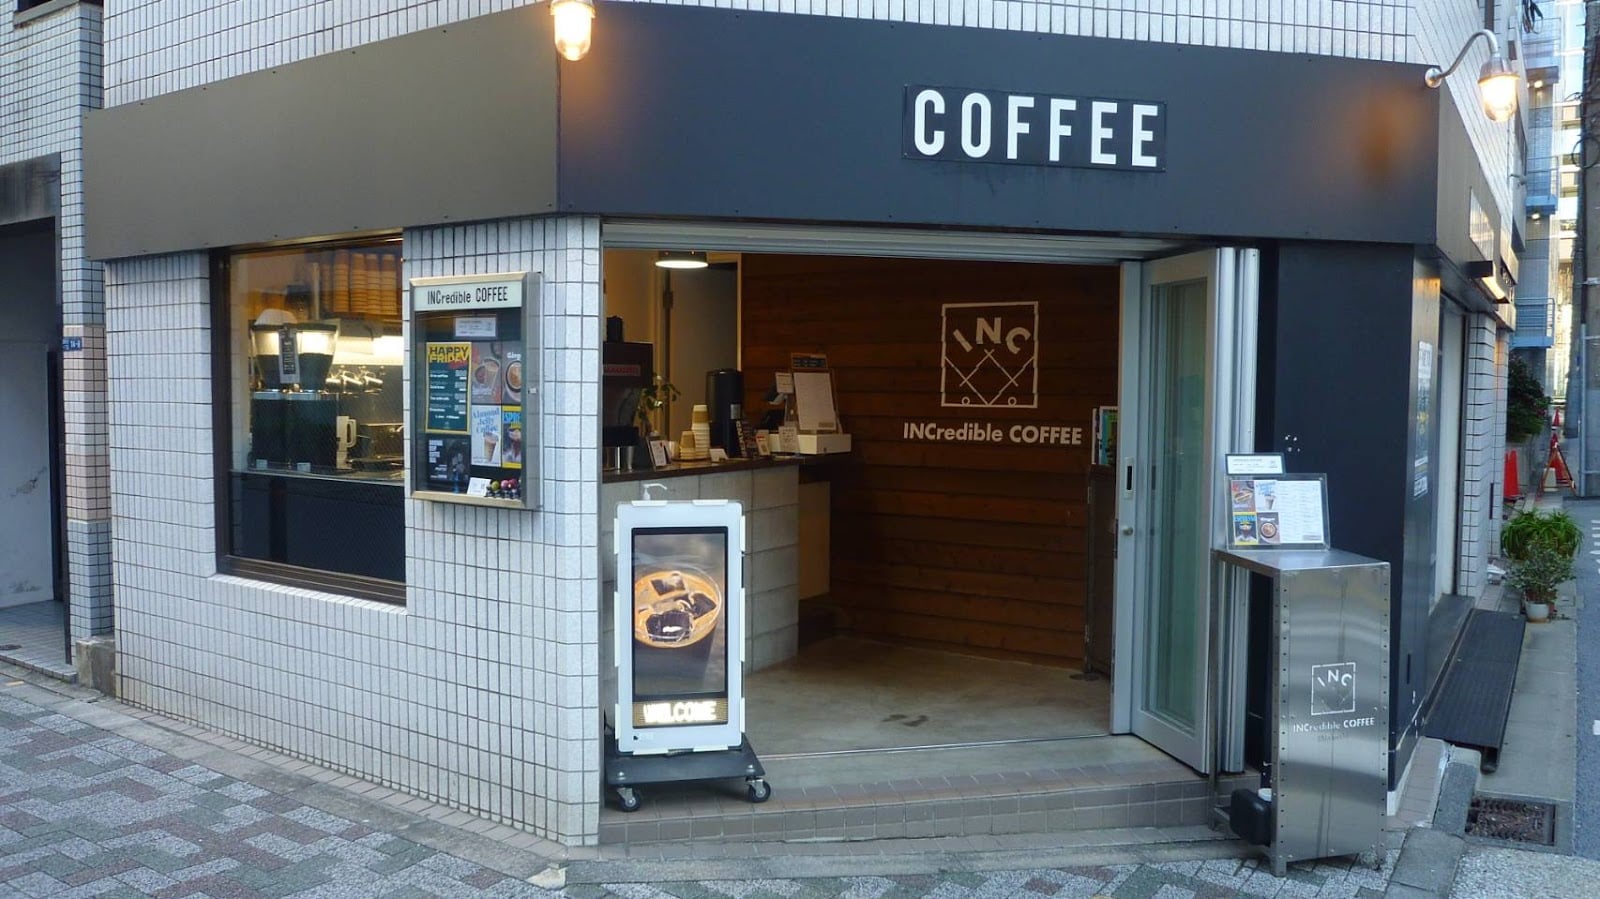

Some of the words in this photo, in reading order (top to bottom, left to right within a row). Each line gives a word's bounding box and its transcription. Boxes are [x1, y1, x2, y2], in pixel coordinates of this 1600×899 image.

[914, 89, 1158, 168] COFFEE
[428, 289, 472, 304] INCredible
[475, 286, 509, 302] COFFEE
[953, 317, 1031, 354] INC
[429, 346, 468, 355] HAPPY
[429, 353, 469, 363] FRIDAY
[903, 422, 1003, 442] INCredible
[1009, 425, 1082, 445] COFFEE
[1317, 669, 1352, 687] INC
[1343, 717, 1375, 728] COFFEE
